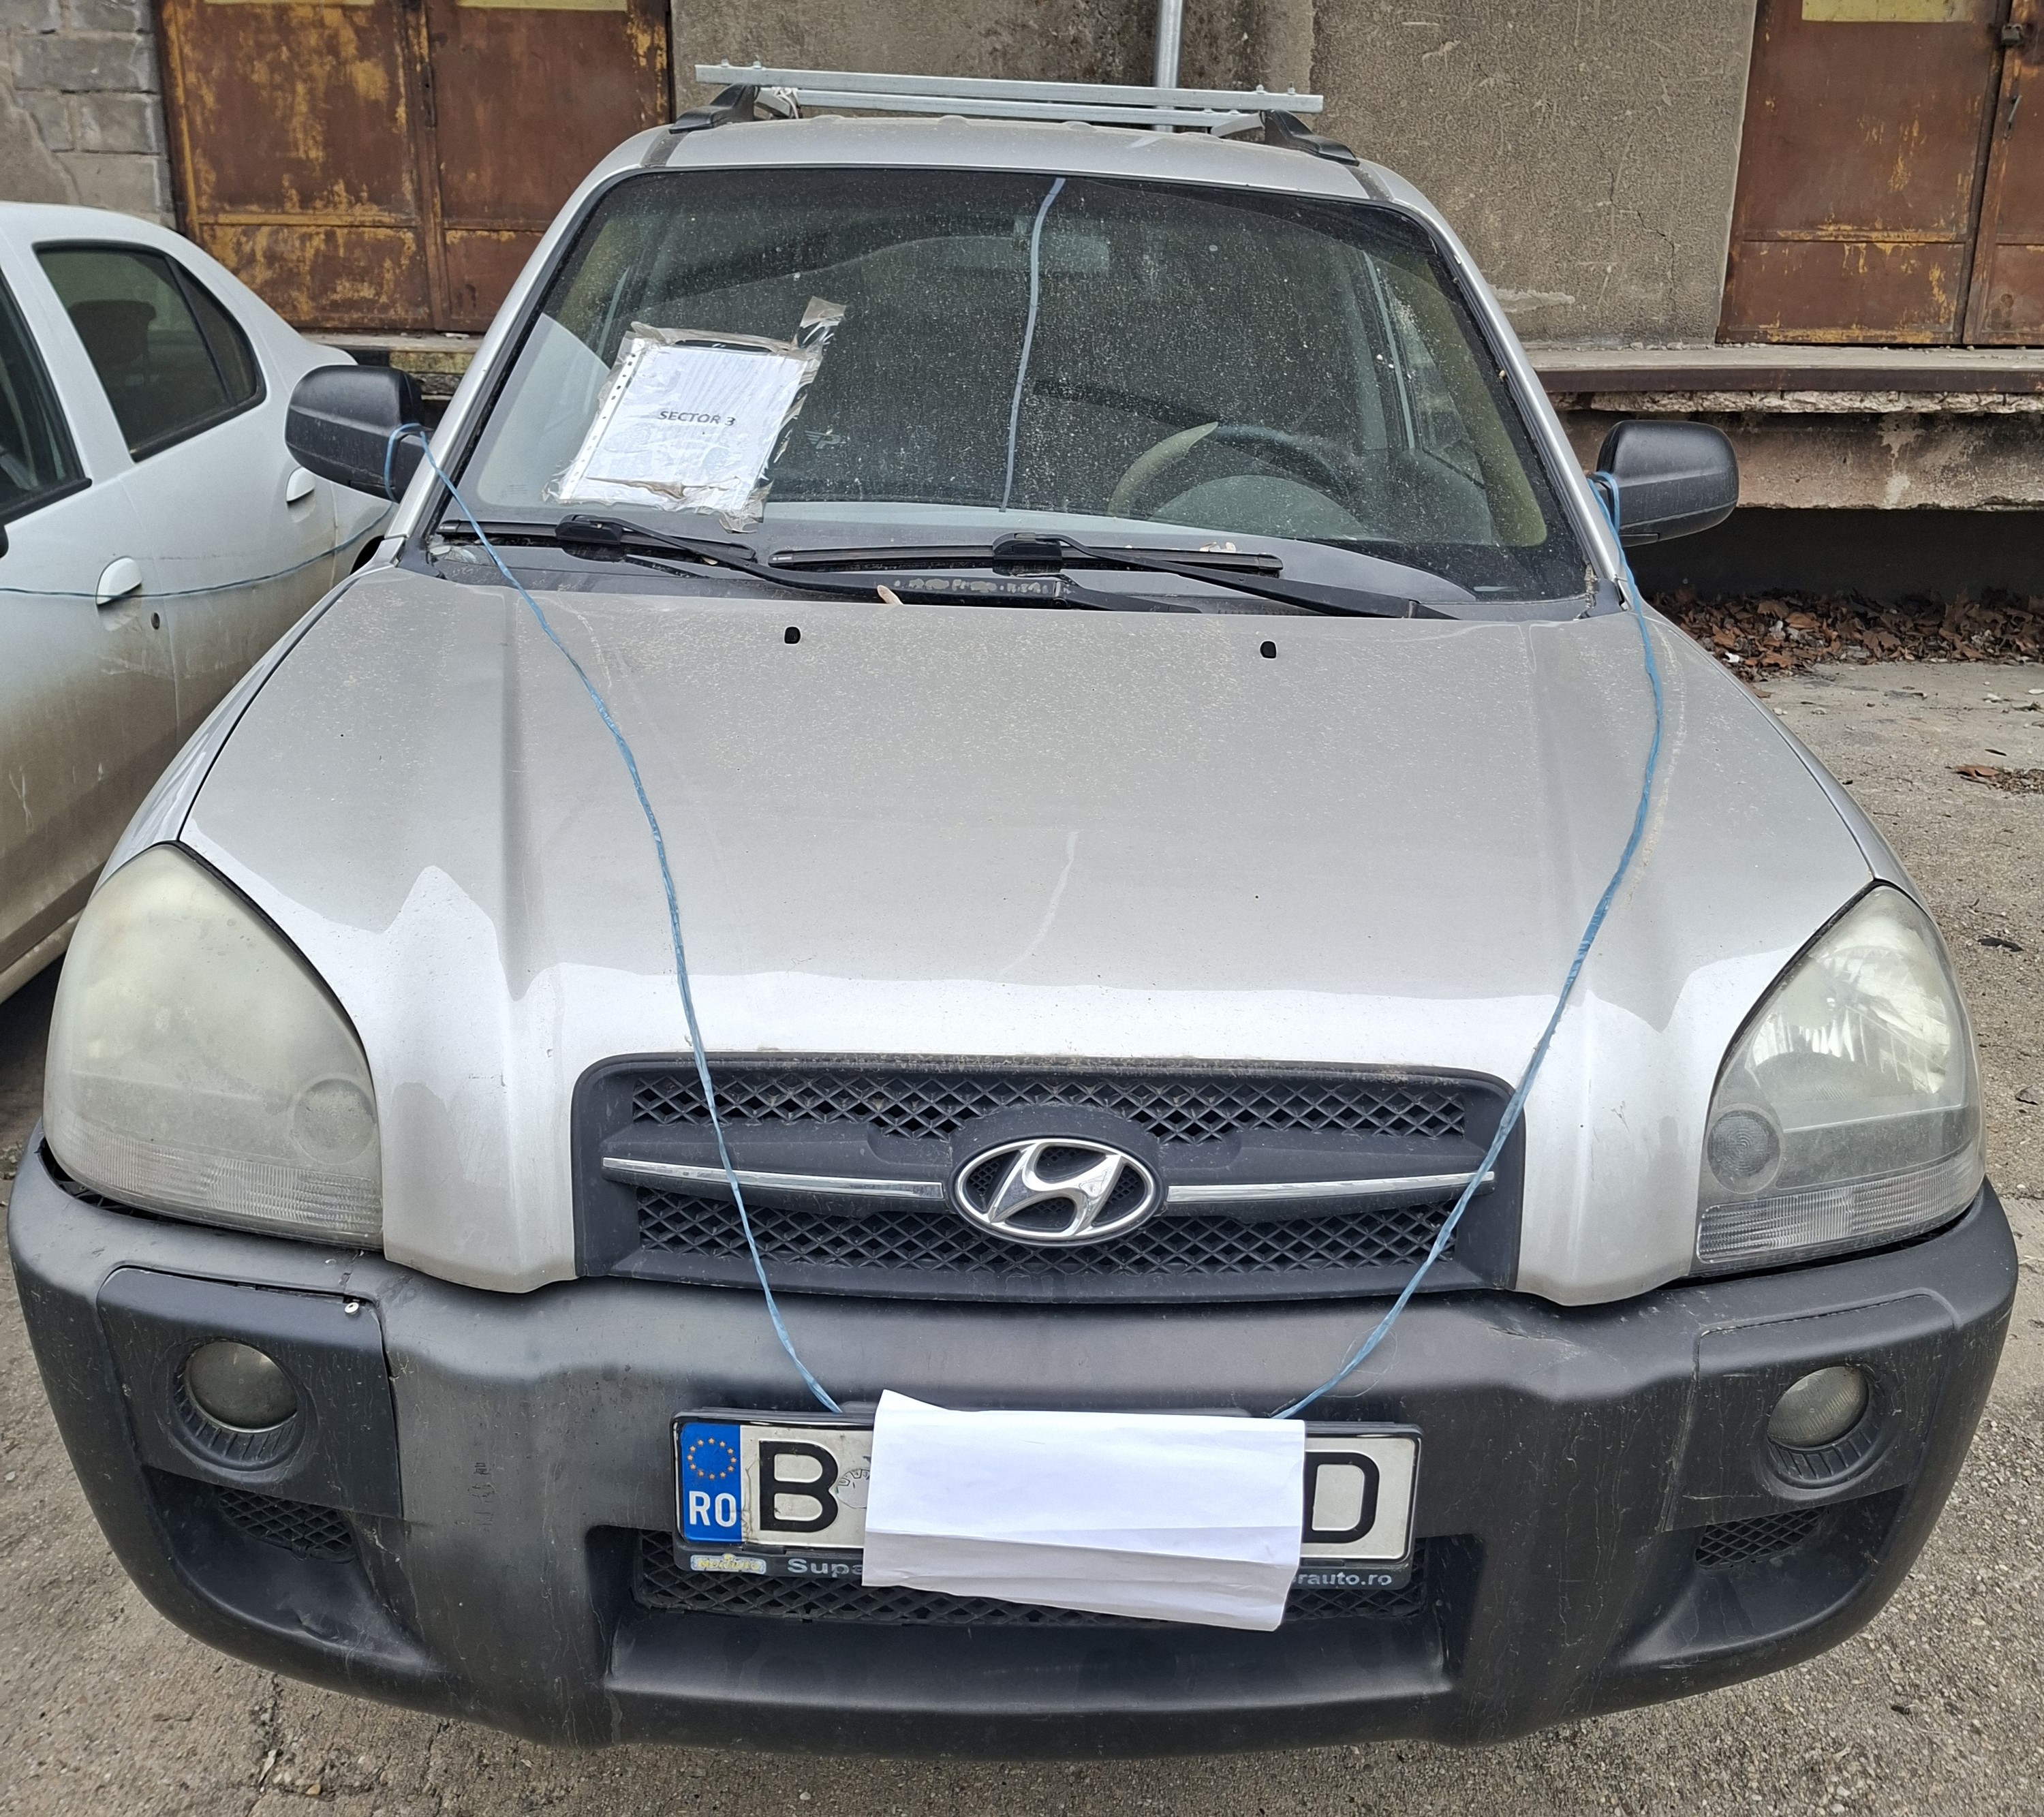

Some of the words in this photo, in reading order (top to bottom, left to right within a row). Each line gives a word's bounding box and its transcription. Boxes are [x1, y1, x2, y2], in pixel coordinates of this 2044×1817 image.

[657, 411, 721, 424] SECTOR
[724, 416, 736, 426] 3
[758, 1440, 839, 1533] B
[1302, 1451, 1380, 1544] D
[688, 1491, 737, 1527] RO
[1292, 1572, 1392, 1586] rauto.ro
